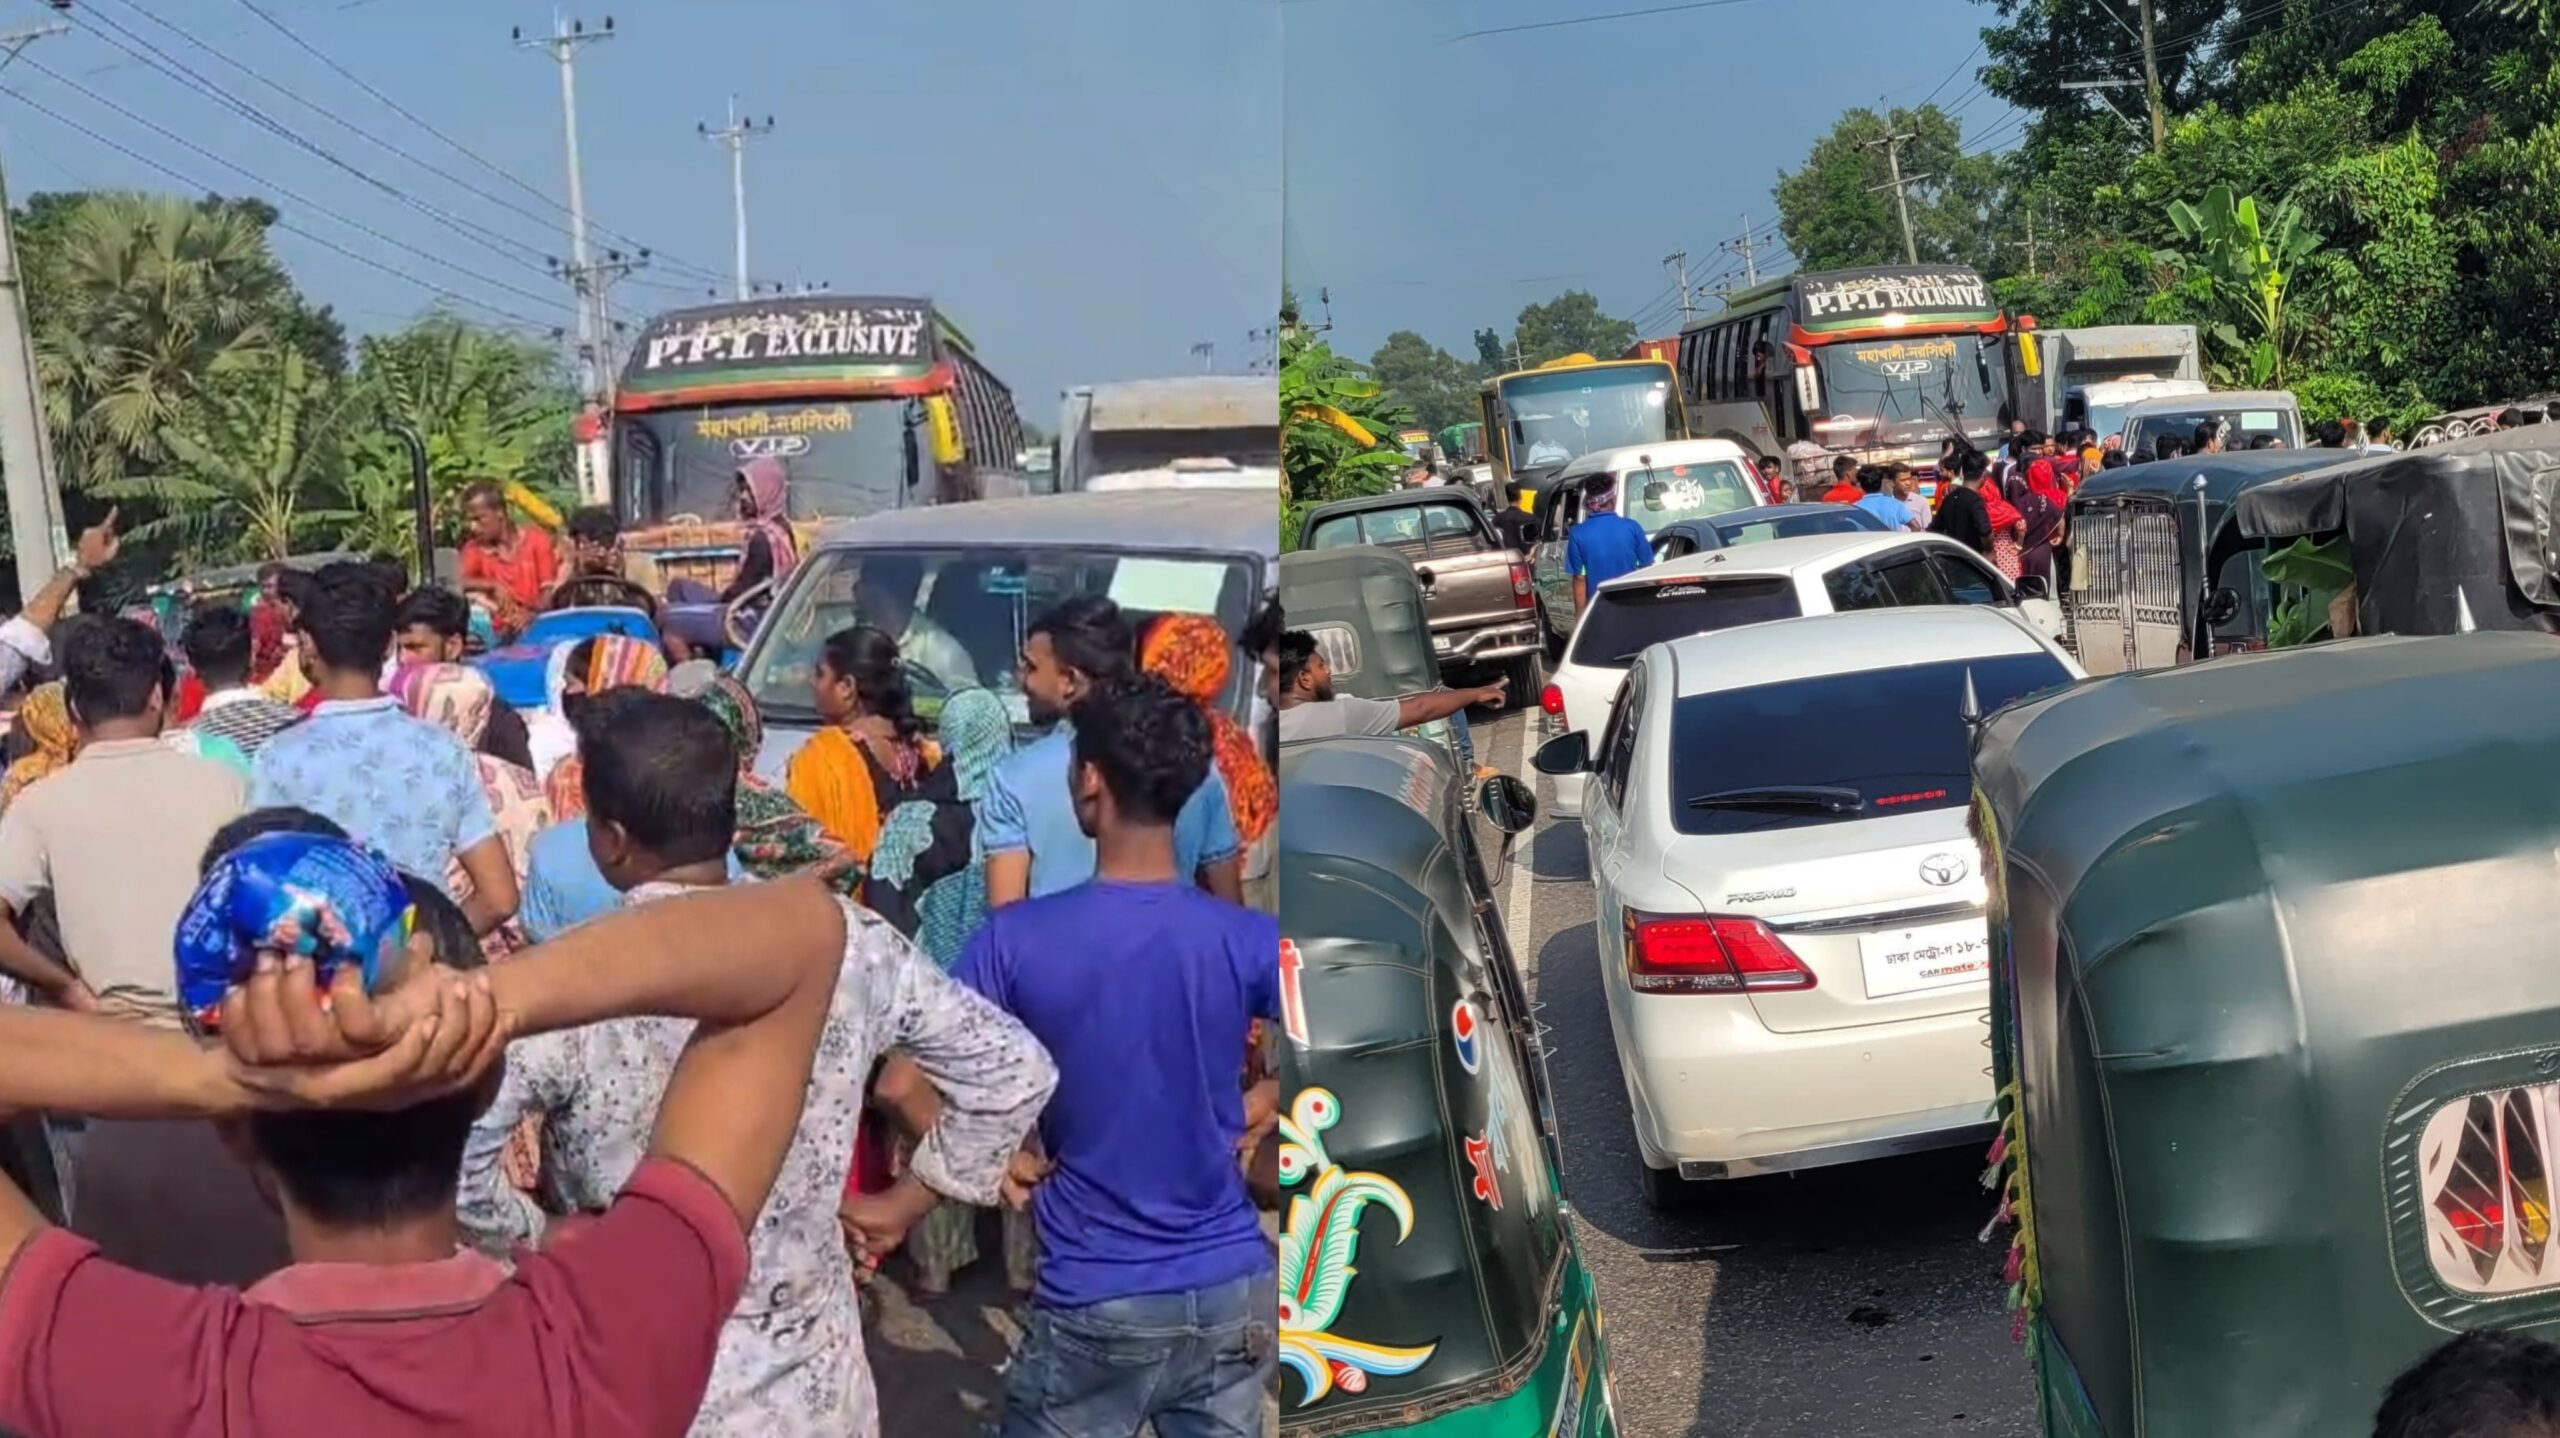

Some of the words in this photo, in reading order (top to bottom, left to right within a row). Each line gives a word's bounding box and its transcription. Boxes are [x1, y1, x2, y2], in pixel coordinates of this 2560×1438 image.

[1890, 284, 1987, 309] EXCLUSIVE
[764, 323, 918, 357] EXCLUSIVE
[1726, 887, 1797, 905] PREMIO
[1885, 951, 1910, 965] ঢাকা
